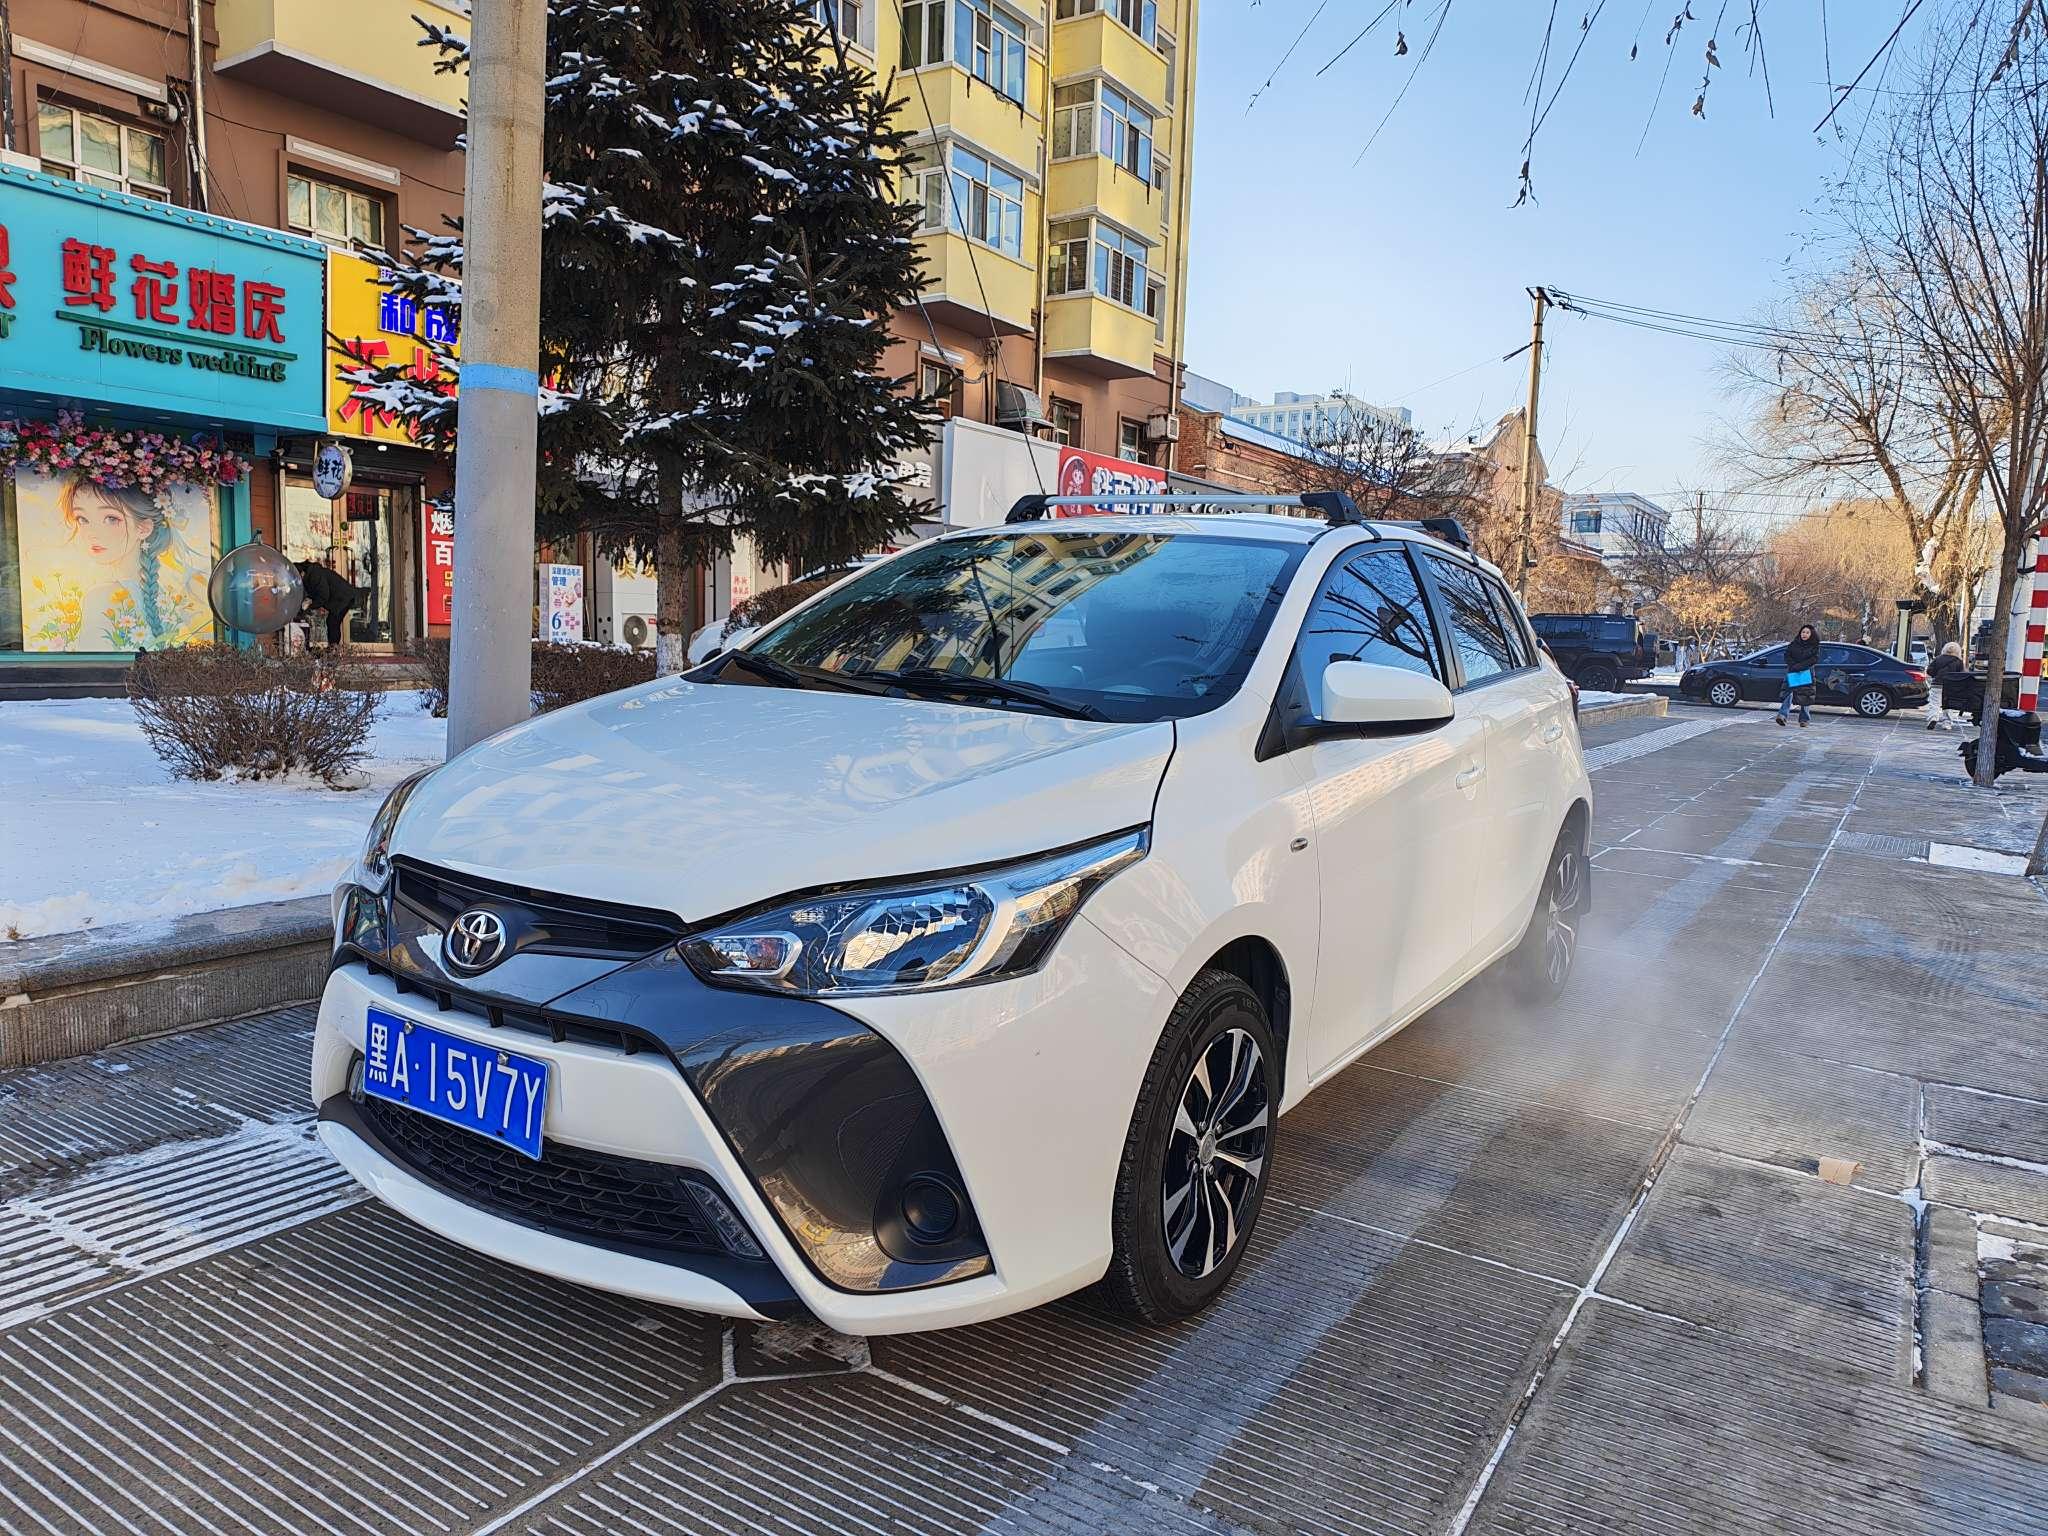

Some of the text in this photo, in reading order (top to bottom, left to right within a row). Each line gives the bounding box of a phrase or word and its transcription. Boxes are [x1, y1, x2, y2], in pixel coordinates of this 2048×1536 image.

[62, 237, 286, 343] 鲜花婚庆
[79, 326, 287, 382] Flowers wedding
[317, 456, 342, 481] 鲜花
[551, 612, 562, 630] 6
